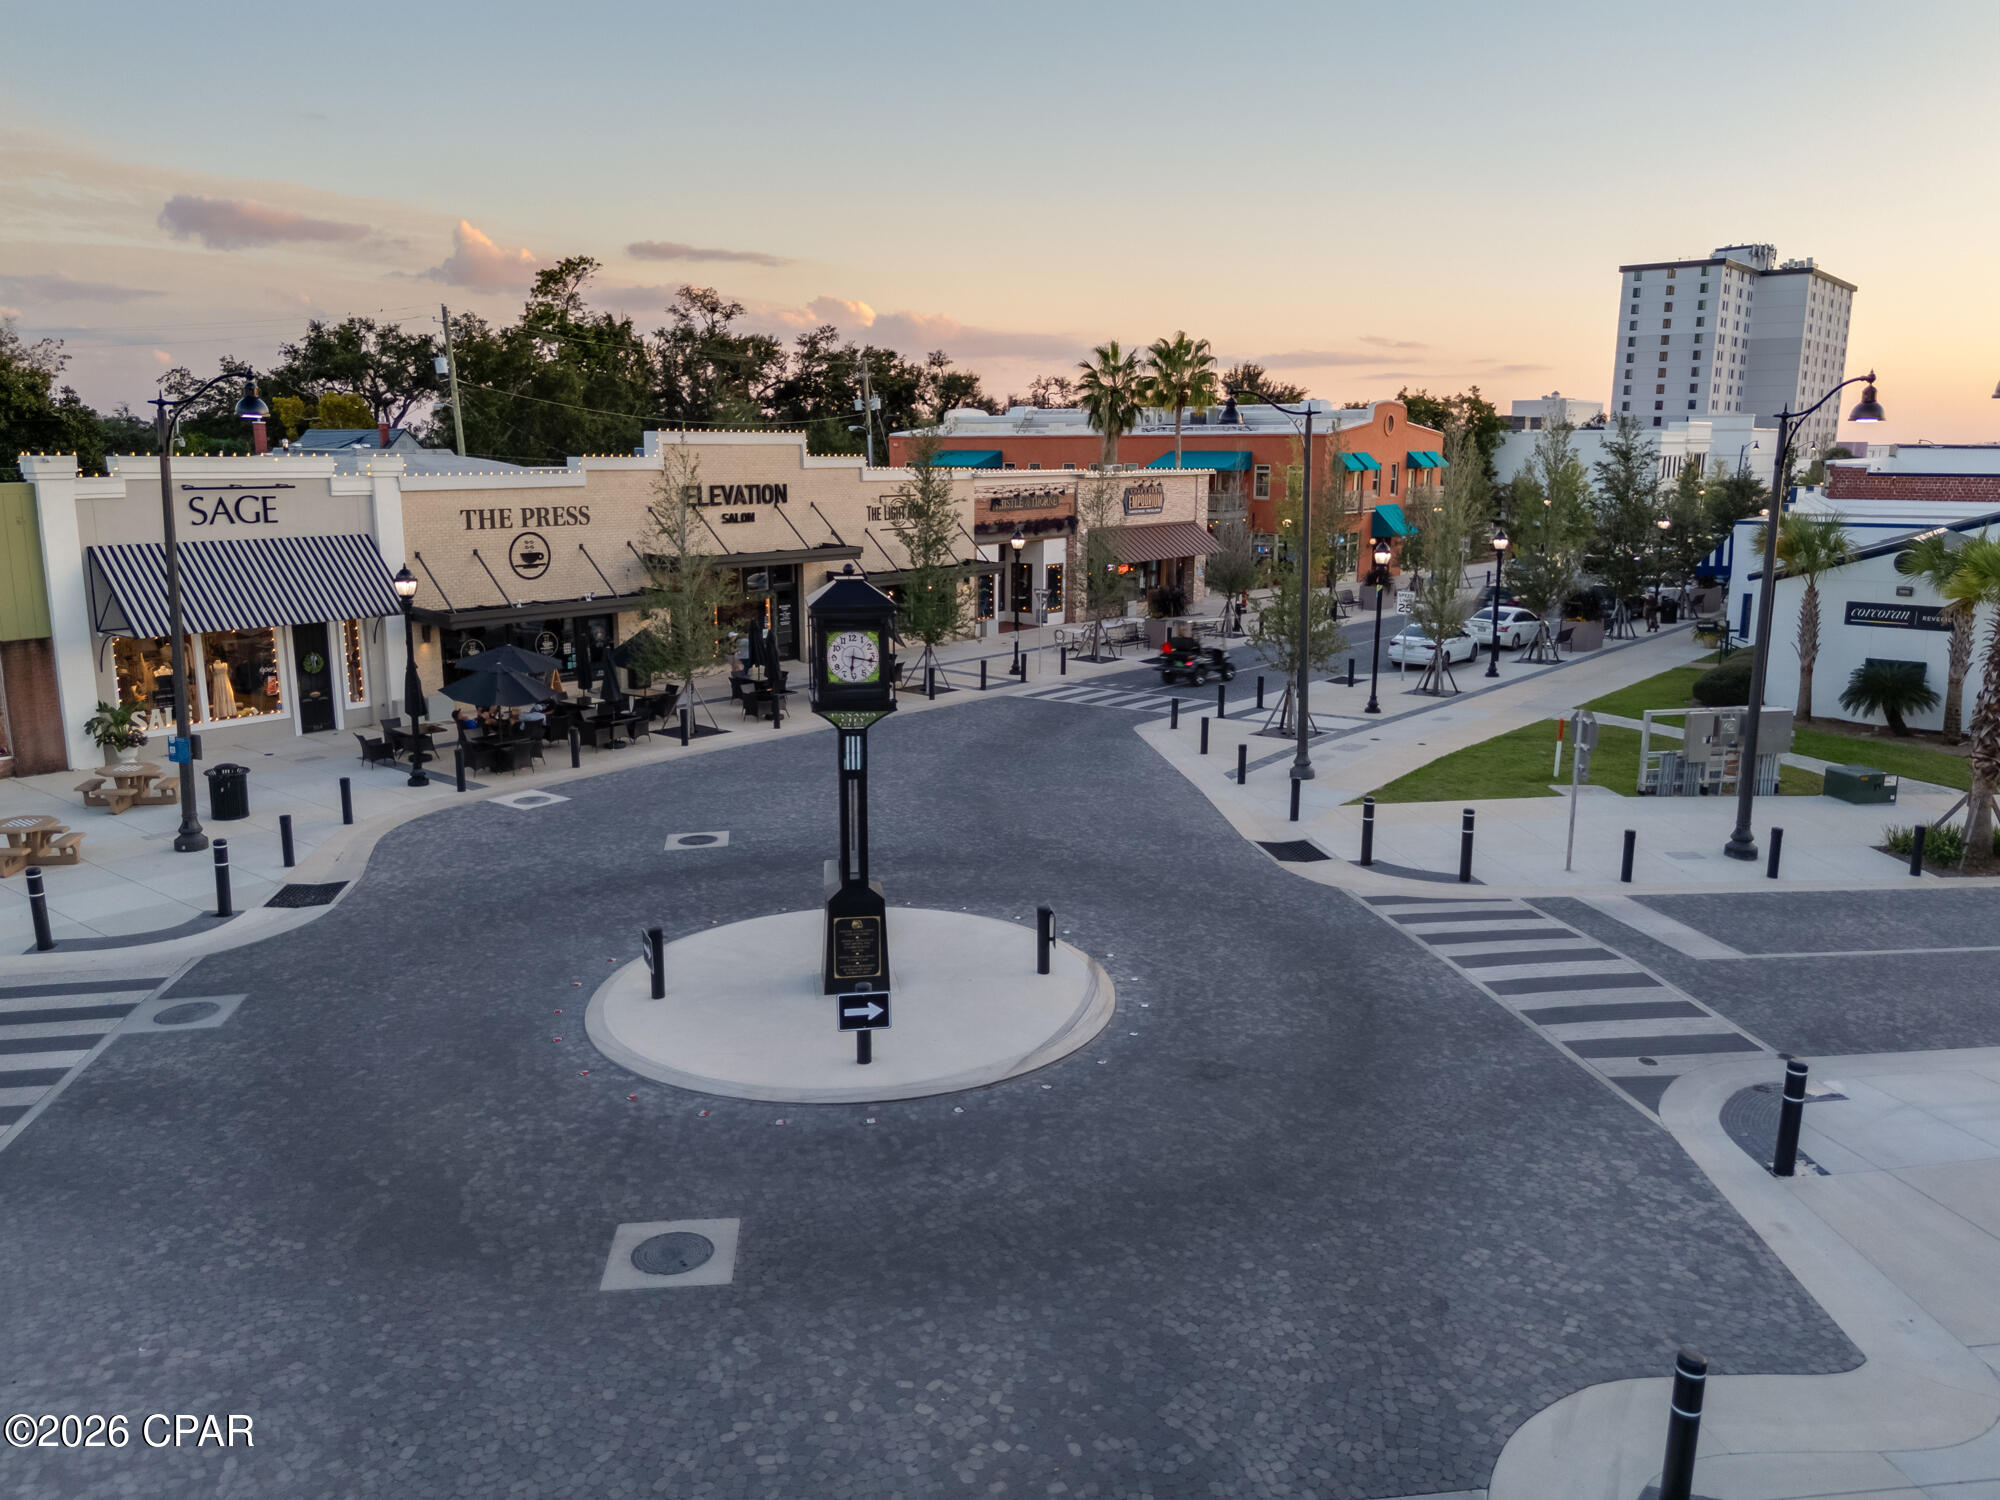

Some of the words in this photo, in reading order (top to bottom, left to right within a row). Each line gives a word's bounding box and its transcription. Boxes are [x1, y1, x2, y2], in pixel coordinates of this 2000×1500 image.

[685, 484, 788, 507] ELEVATION
[188, 495, 279, 526] SAGE
[866, 505, 881, 522] THE
[460, 508, 513, 531] THE
[520, 505, 591, 528] PRESS
[721, 512, 756, 524] SALON
[1398, 603, 1411, 613] 25
[1850, 607, 1911, 620] corcoran
[840, 637, 846, 645] 11
[848, 634, 857, 642] 12
[866, 643, 873, 651] 2
[834, 663, 841, 671] 8
[861, 670, 867, 678] 5
